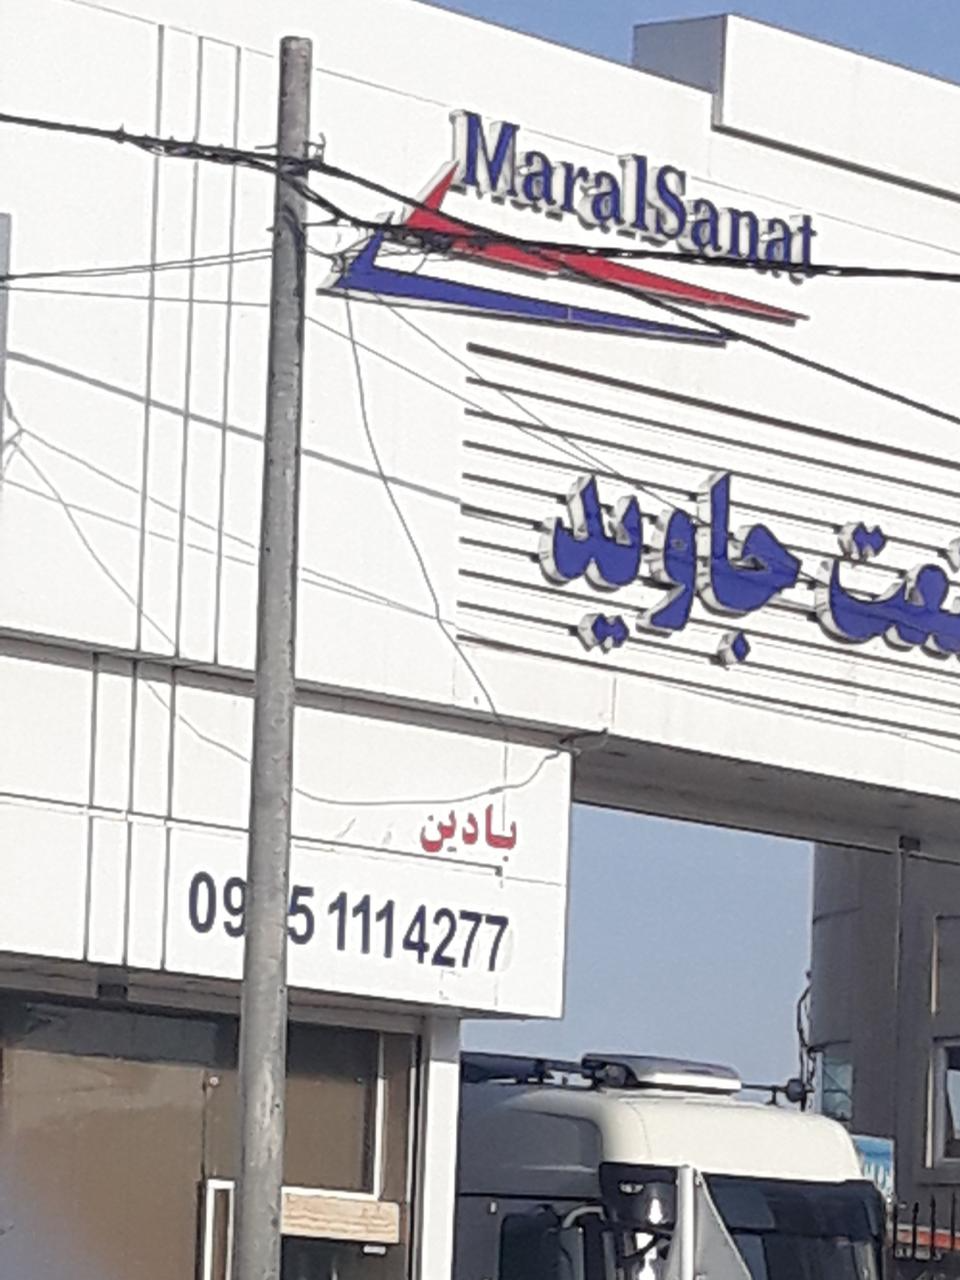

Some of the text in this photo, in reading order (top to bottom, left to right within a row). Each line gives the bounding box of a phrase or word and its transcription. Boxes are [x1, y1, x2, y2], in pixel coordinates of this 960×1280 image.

[450, 110, 817, 283] MaralSanat
[540, 471, 799, 665] جاوید
[419, 804, 518, 862] بادین
[188, 870, 315, 945] 095
